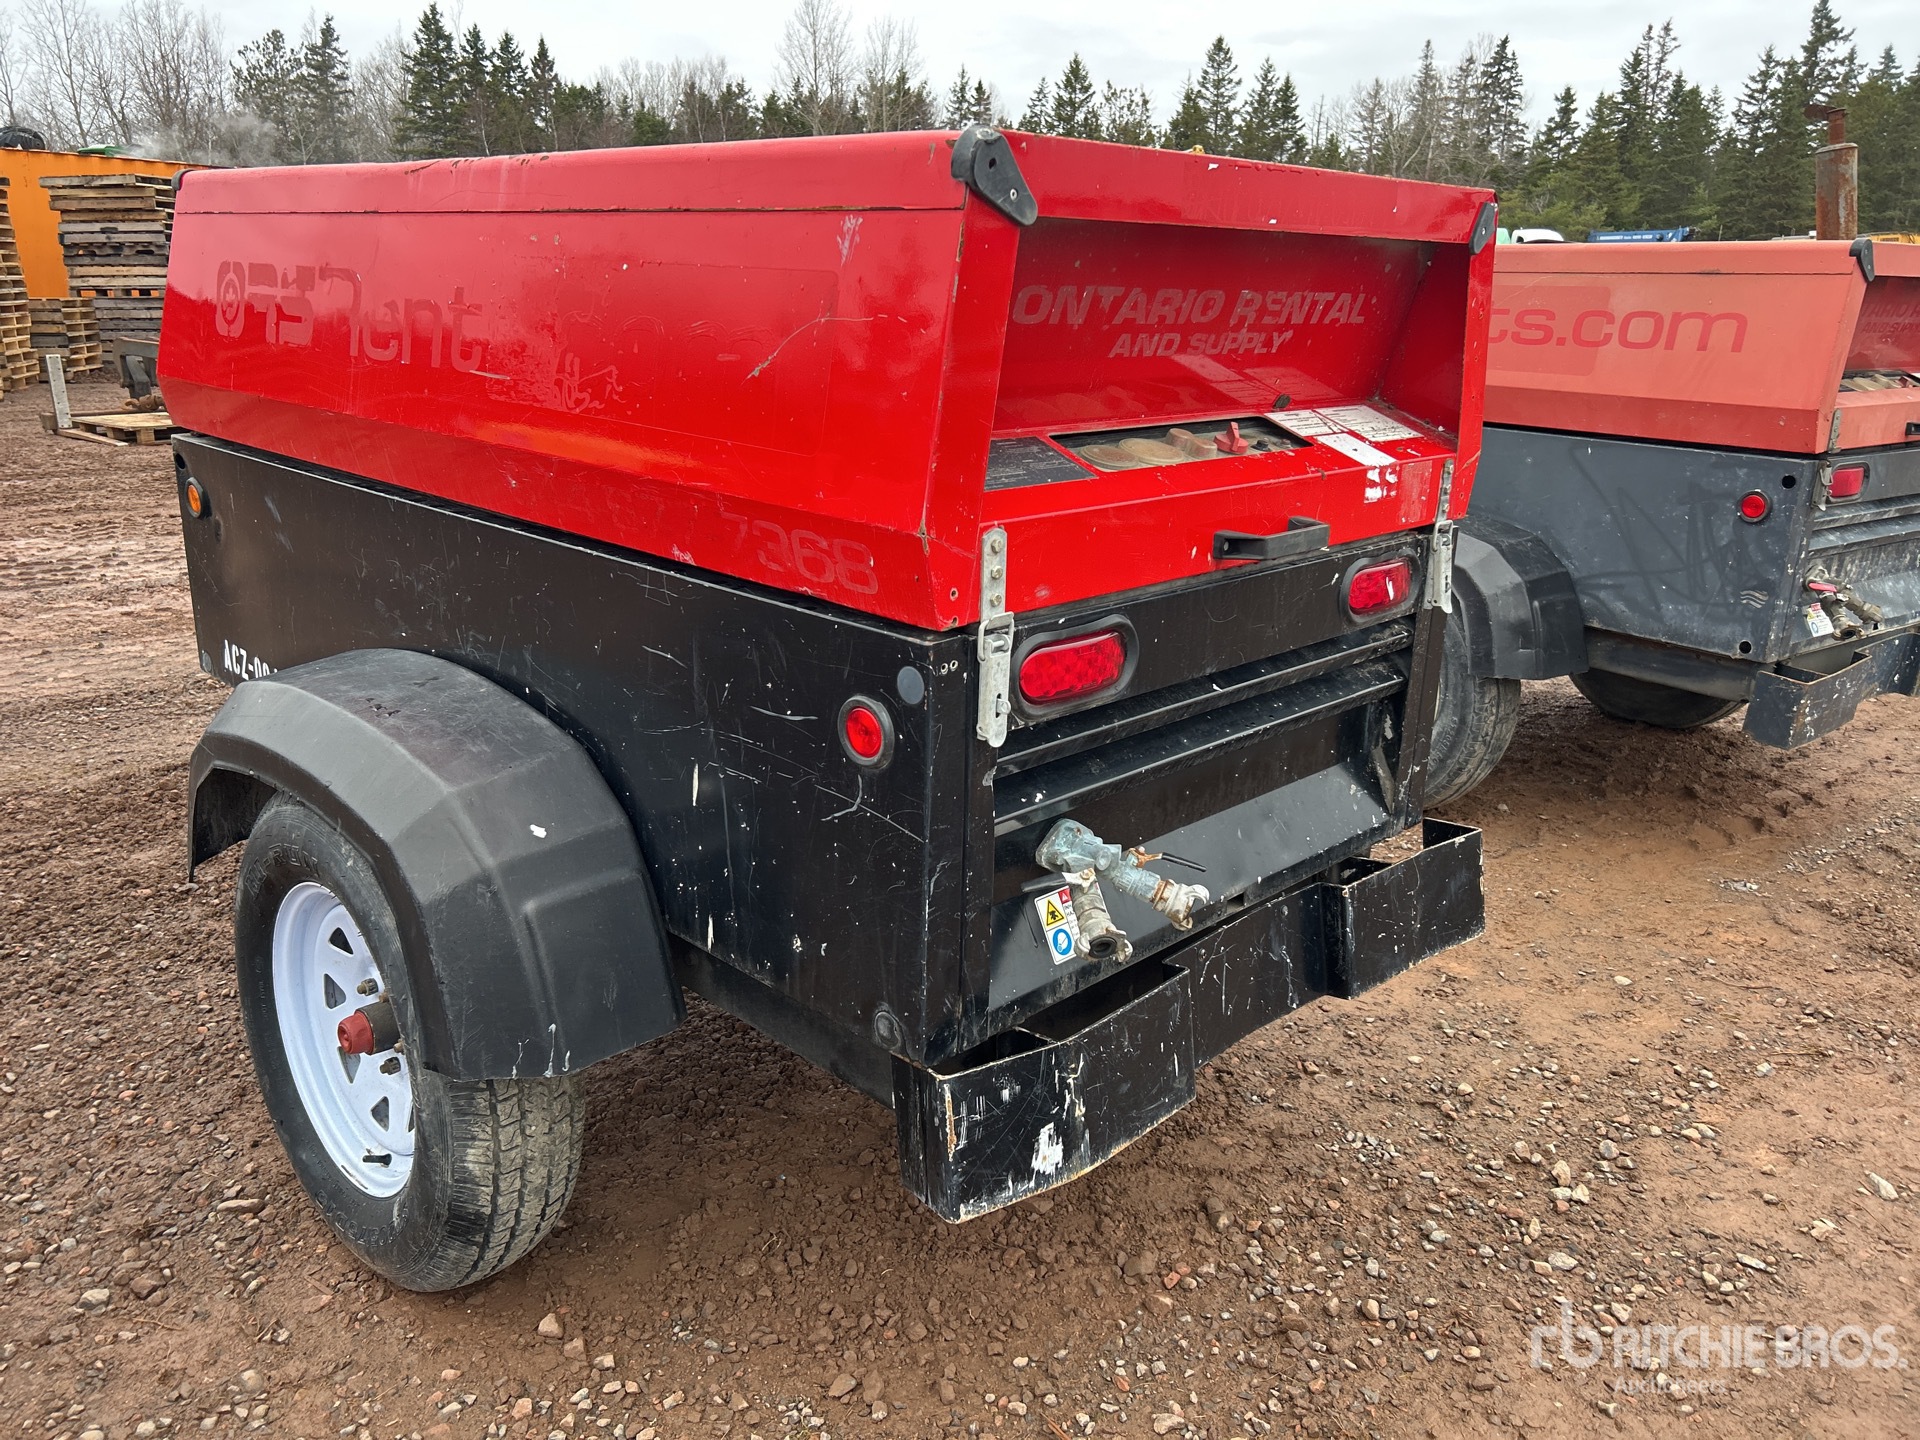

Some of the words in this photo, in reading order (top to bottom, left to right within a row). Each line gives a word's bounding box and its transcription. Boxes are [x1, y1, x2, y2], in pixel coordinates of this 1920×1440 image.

[1013, 285, 1221, 329] ONTARIO
[1230, 290, 1367, 326] RENTAL
[1109, 332, 1178, 358] AND
[1186, 329, 1293, 356] SUPPLY
[720, 511, 879, 595] 7368
